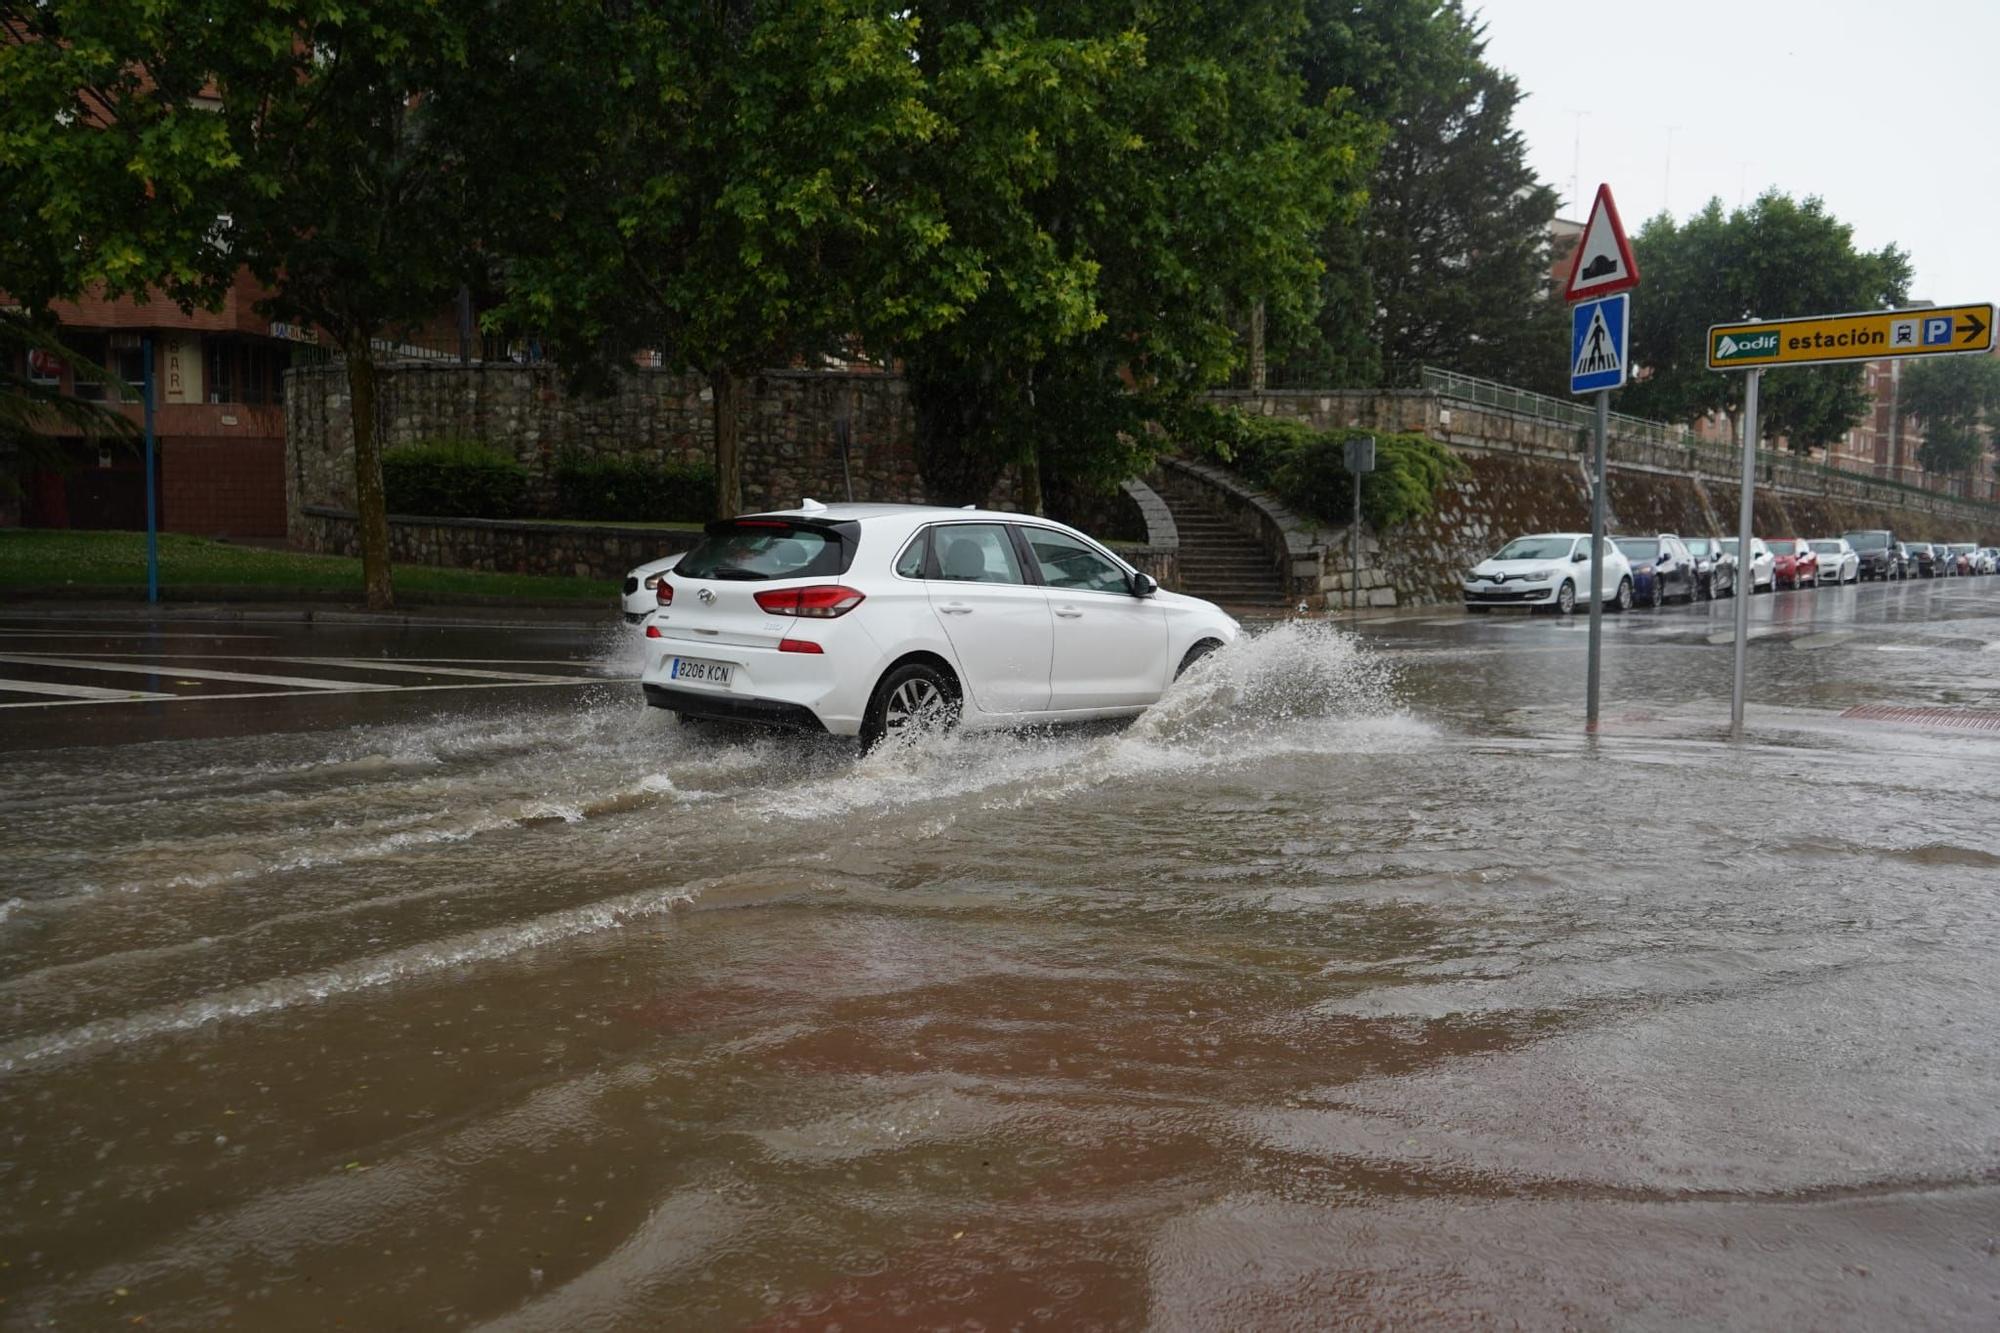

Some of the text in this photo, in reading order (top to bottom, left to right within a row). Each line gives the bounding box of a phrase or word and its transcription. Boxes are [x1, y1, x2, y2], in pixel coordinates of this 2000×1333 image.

[1739, 320, 1947, 350] adif estación P
[168, 339, 180, 387] BAR
[679, 662, 728, 682] 8206 KCN
